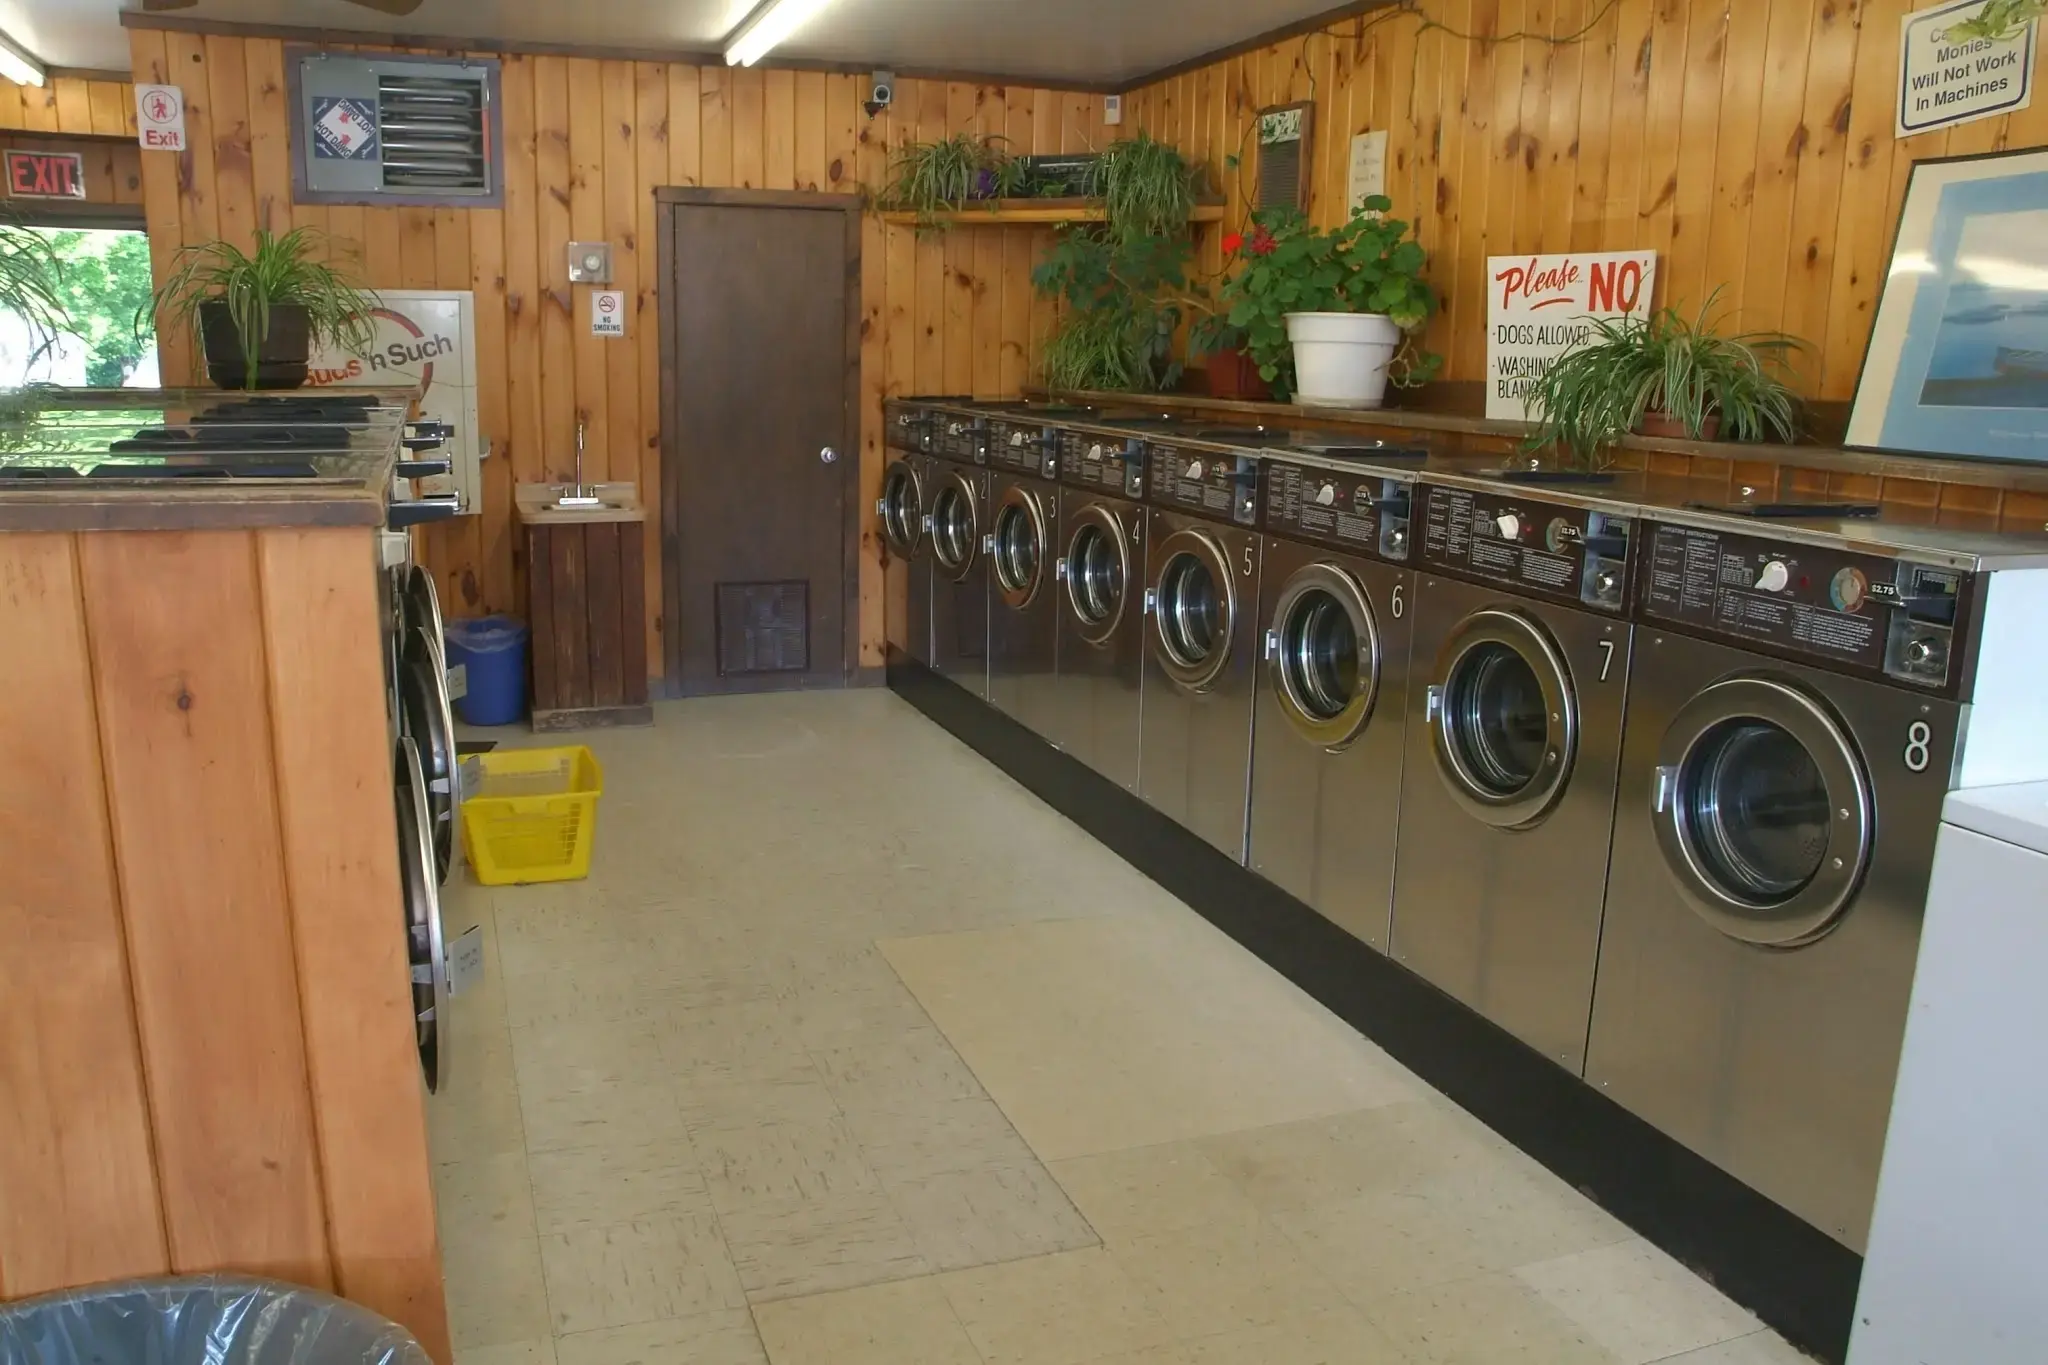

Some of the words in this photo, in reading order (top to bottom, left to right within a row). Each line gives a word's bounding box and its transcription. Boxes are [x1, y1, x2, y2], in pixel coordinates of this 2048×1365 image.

[1937, 40, 1993, 64] Monies
[1912, 71, 1939, 91] Will
[1944, 64, 1971, 83] Not
[1976, 51, 2018, 74] Work
[1916, 97, 1929, 112] In
[1934, 77, 2009, 107] Machines
[146, 129, 180, 146] Exit
[315, 121, 334, 139] HOT
[357, 119, 376, 137] HOT
[10, 155, 76, 194] EXIT
[593, 323, 621, 332] SMOKING
[602, 316, 612, 324] NO
[1498, 325, 1534, 346] DOGS
[387, 333, 453, 367] Such
[981, 472, 986, 499] 2
[1049, 496, 1056, 518] 3
[1132, 520, 1140, 545] 4
[1243, 548, 1253, 576] 5
[1392, 584, 1403, 618] 6
[1871, 584, 1895, 596] $2.75
[1599, 641, 1614, 681] 7
[1904, 721, 1931, 771] 8
